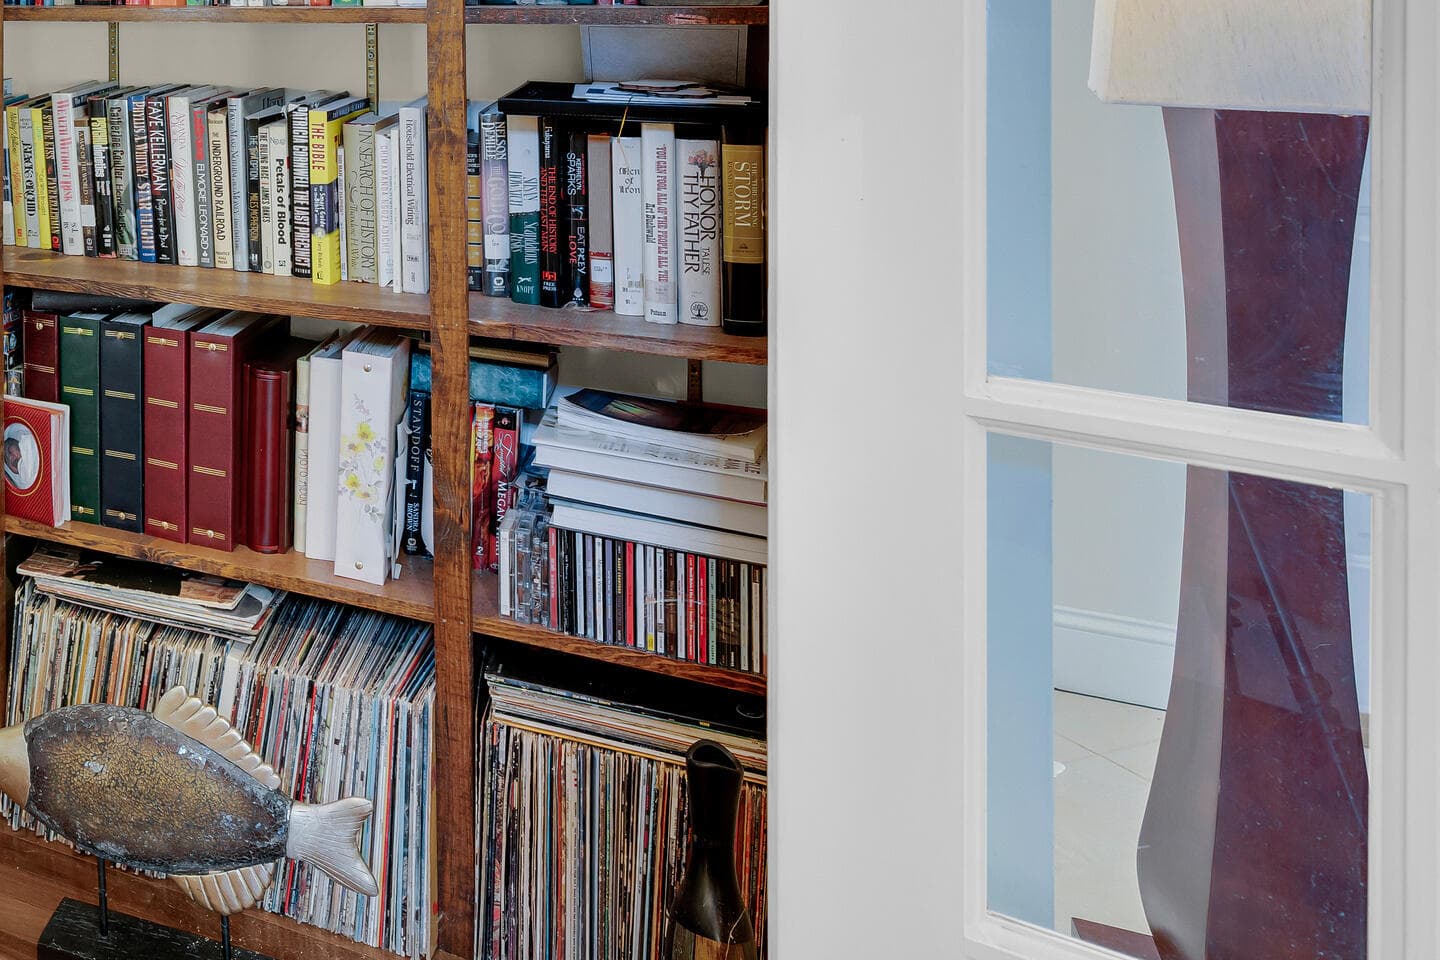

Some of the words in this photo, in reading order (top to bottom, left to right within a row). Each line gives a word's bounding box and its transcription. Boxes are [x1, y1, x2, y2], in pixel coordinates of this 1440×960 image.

[148, 101, 163, 126] FAYE
[292, 107, 307, 143] PATRICIA
[312, 123, 324, 139] THE
[359, 130, 372, 144] IN
[495, 121, 505, 160] NELSON
[150, 130, 167, 191] KELLERMAN
[212, 140, 223, 197] UNDERGROUND
[293, 145, 308, 187] CORNWELL
[312, 144, 324, 170] BIBLE
[359, 147, 373, 195] SEARCH
[548, 166, 556, 184] THE
[568, 153, 576, 195] SPARKS
[197, 164, 207, 202] ELMORE
[276, 159, 285, 193] Petals
[683, 172, 699, 211] THY
[734, 161, 750, 227] STORM
[277, 196, 285, 208] of
[294, 190, 308, 205] THE
[360, 198, 374, 217] OF
[406, 199, 415, 225] Wiring
[548, 206, 556, 217] OF
[700, 176, 716, 240] HONOR
[198, 205, 208, 249] LEONARD
[215, 200, 225, 240] RAILROAD
[278, 211, 286, 244] Blood
[294, 209, 309, 225] LAST
[294, 227, 310, 267] PRECINCT
[360, 219, 375, 271] HISTORY
[548, 220, 556, 253] HISTORY
[684, 213, 699, 273] FATHER
[577, 248, 585, 274] PREY
[702, 248, 710, 275] TALESE
[413, 400, 423, 472] STANDOFF
[497, 480, 507, 521] MEGAN
